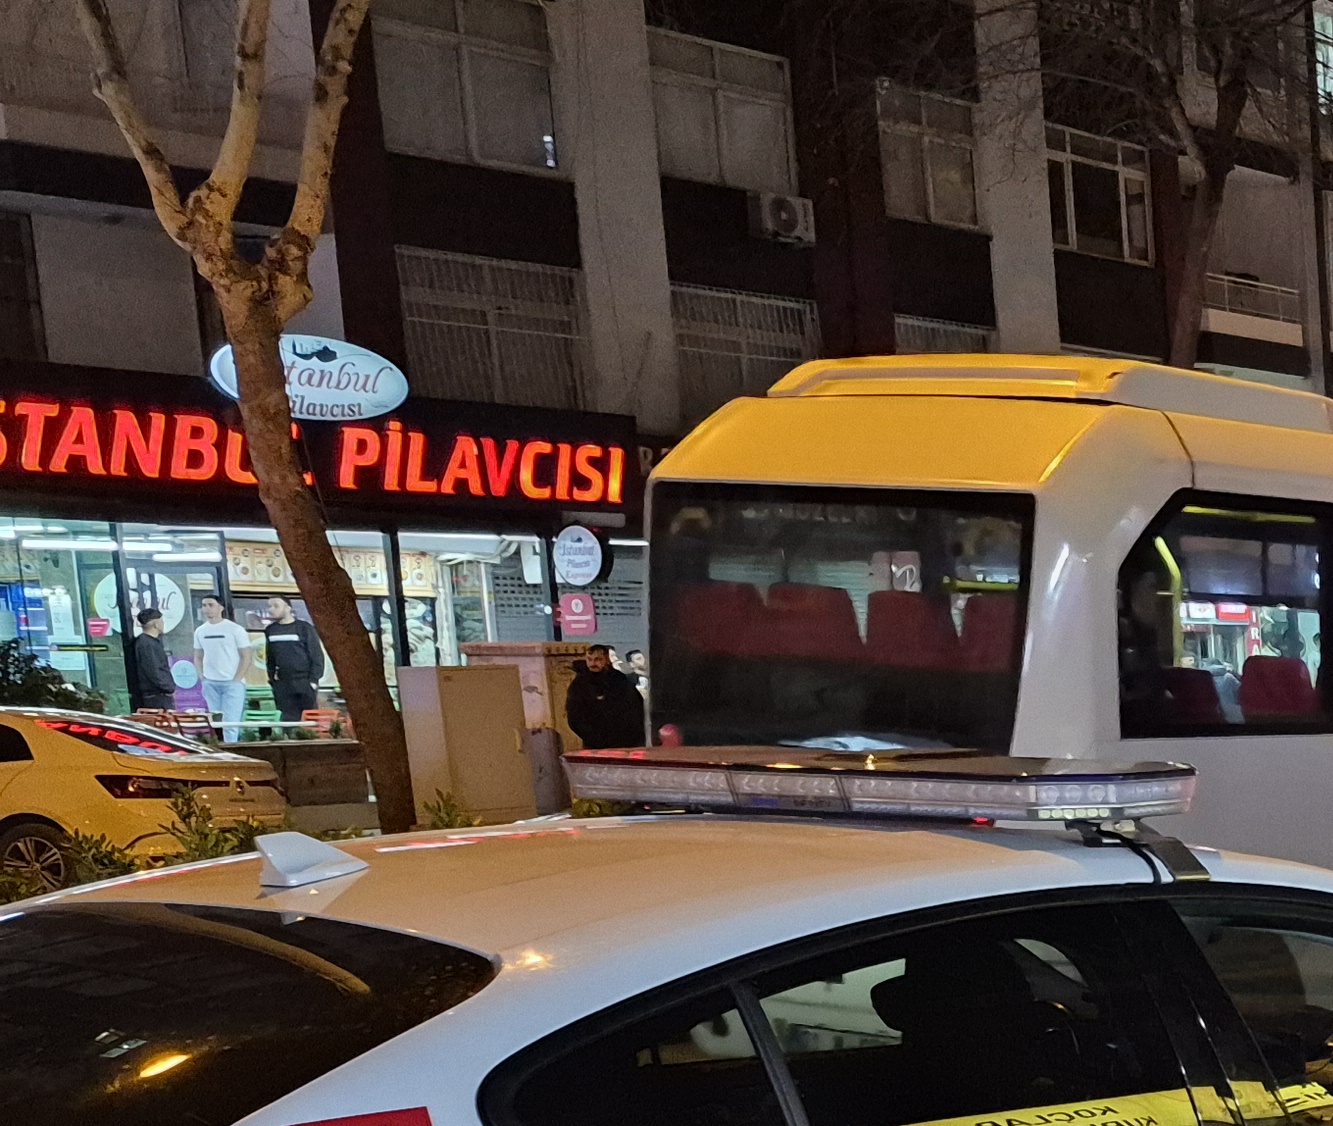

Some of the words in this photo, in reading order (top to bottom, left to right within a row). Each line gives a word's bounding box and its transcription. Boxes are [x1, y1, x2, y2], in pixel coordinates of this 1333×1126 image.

[285, 361, 394, 394] tanbul
[292, 394, 364, 417] ilavcısı
[339, 419, 625, 503] PİLAVCISI
